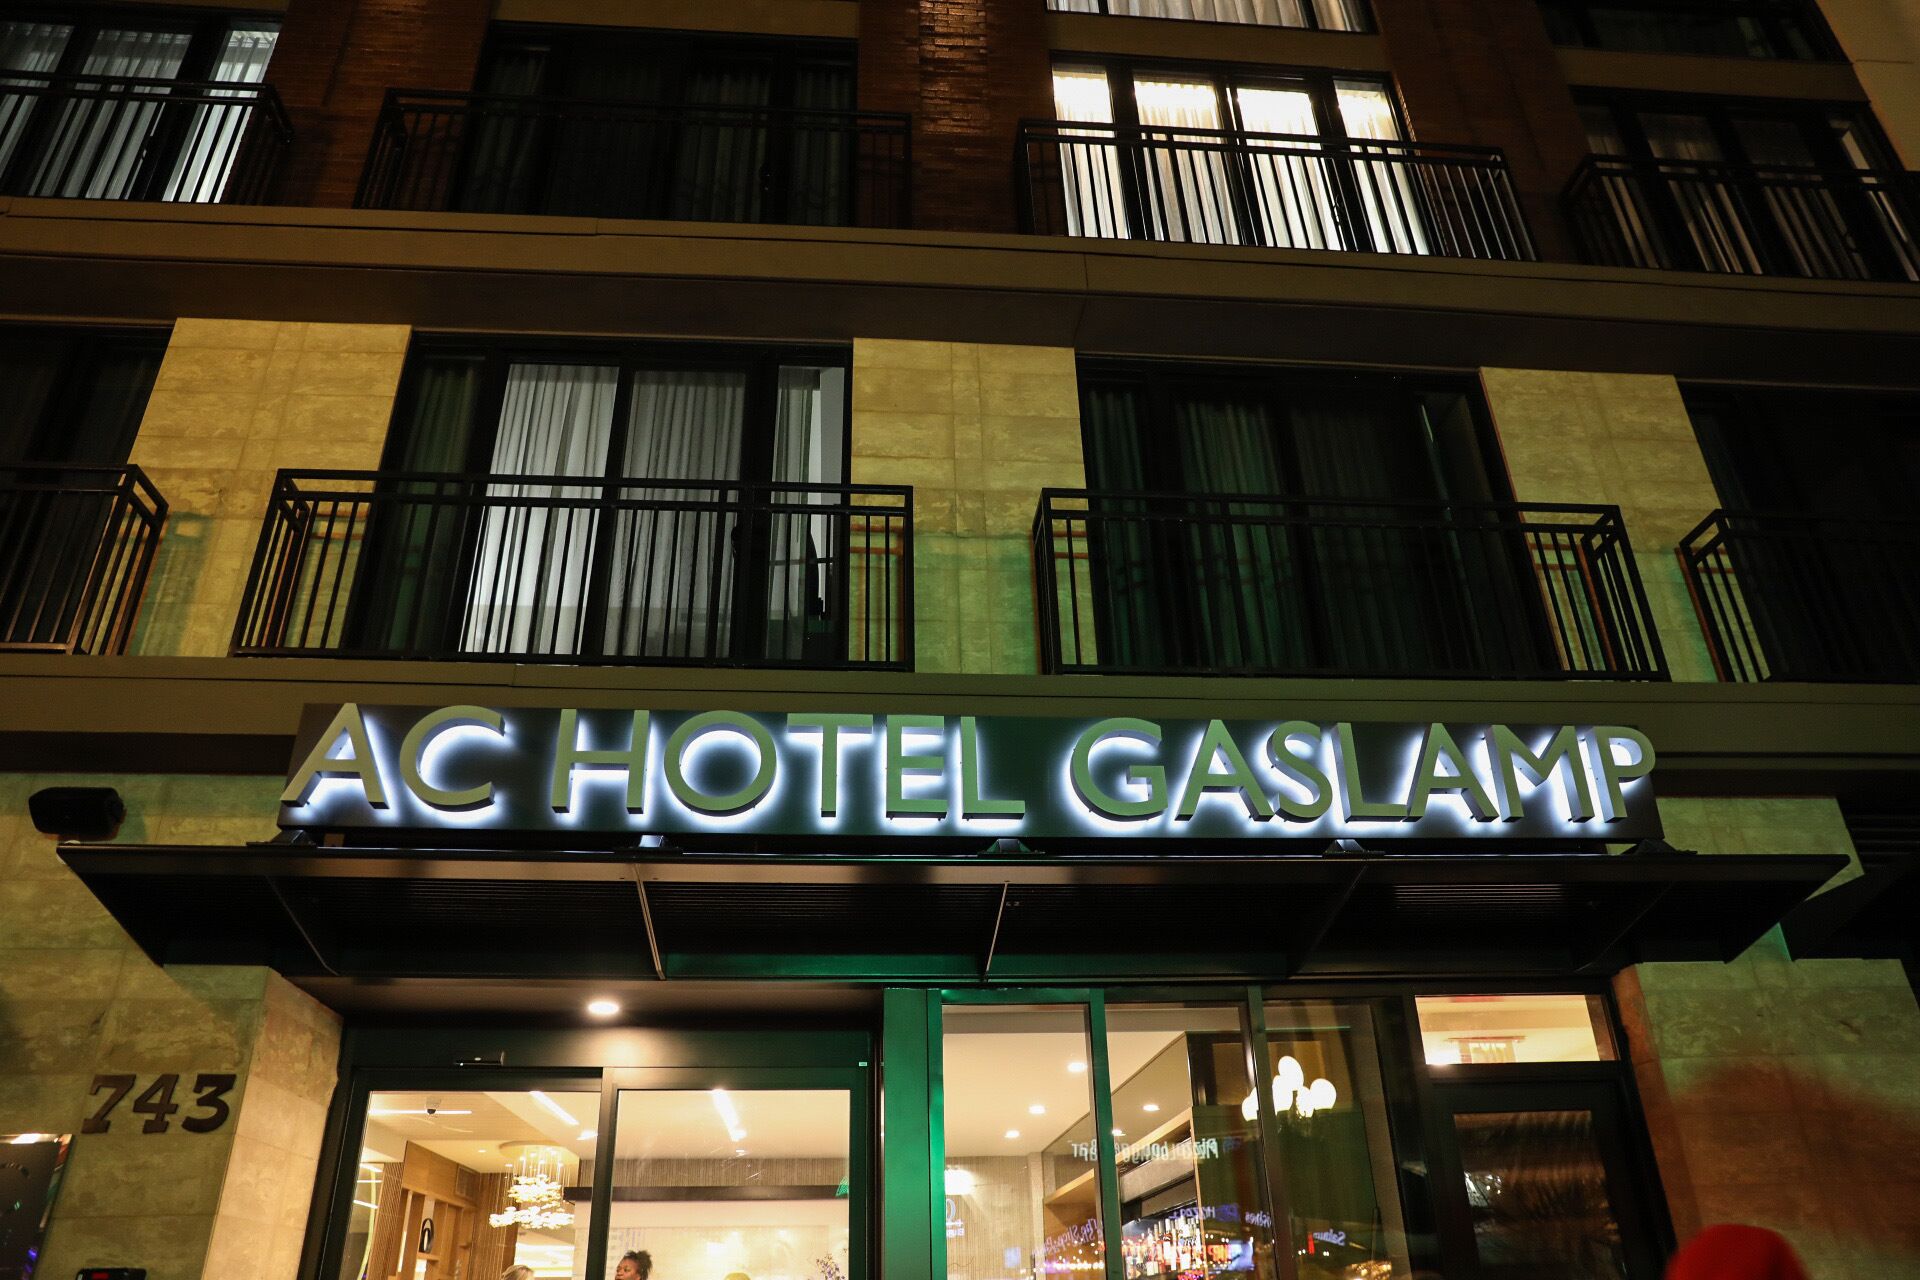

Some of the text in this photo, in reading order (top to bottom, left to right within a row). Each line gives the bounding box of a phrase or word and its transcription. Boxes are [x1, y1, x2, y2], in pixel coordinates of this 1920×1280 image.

[280, 702, 1656, 824] AC HOTEL GASLAMP
[81, 1074, 237, 1134] 743
